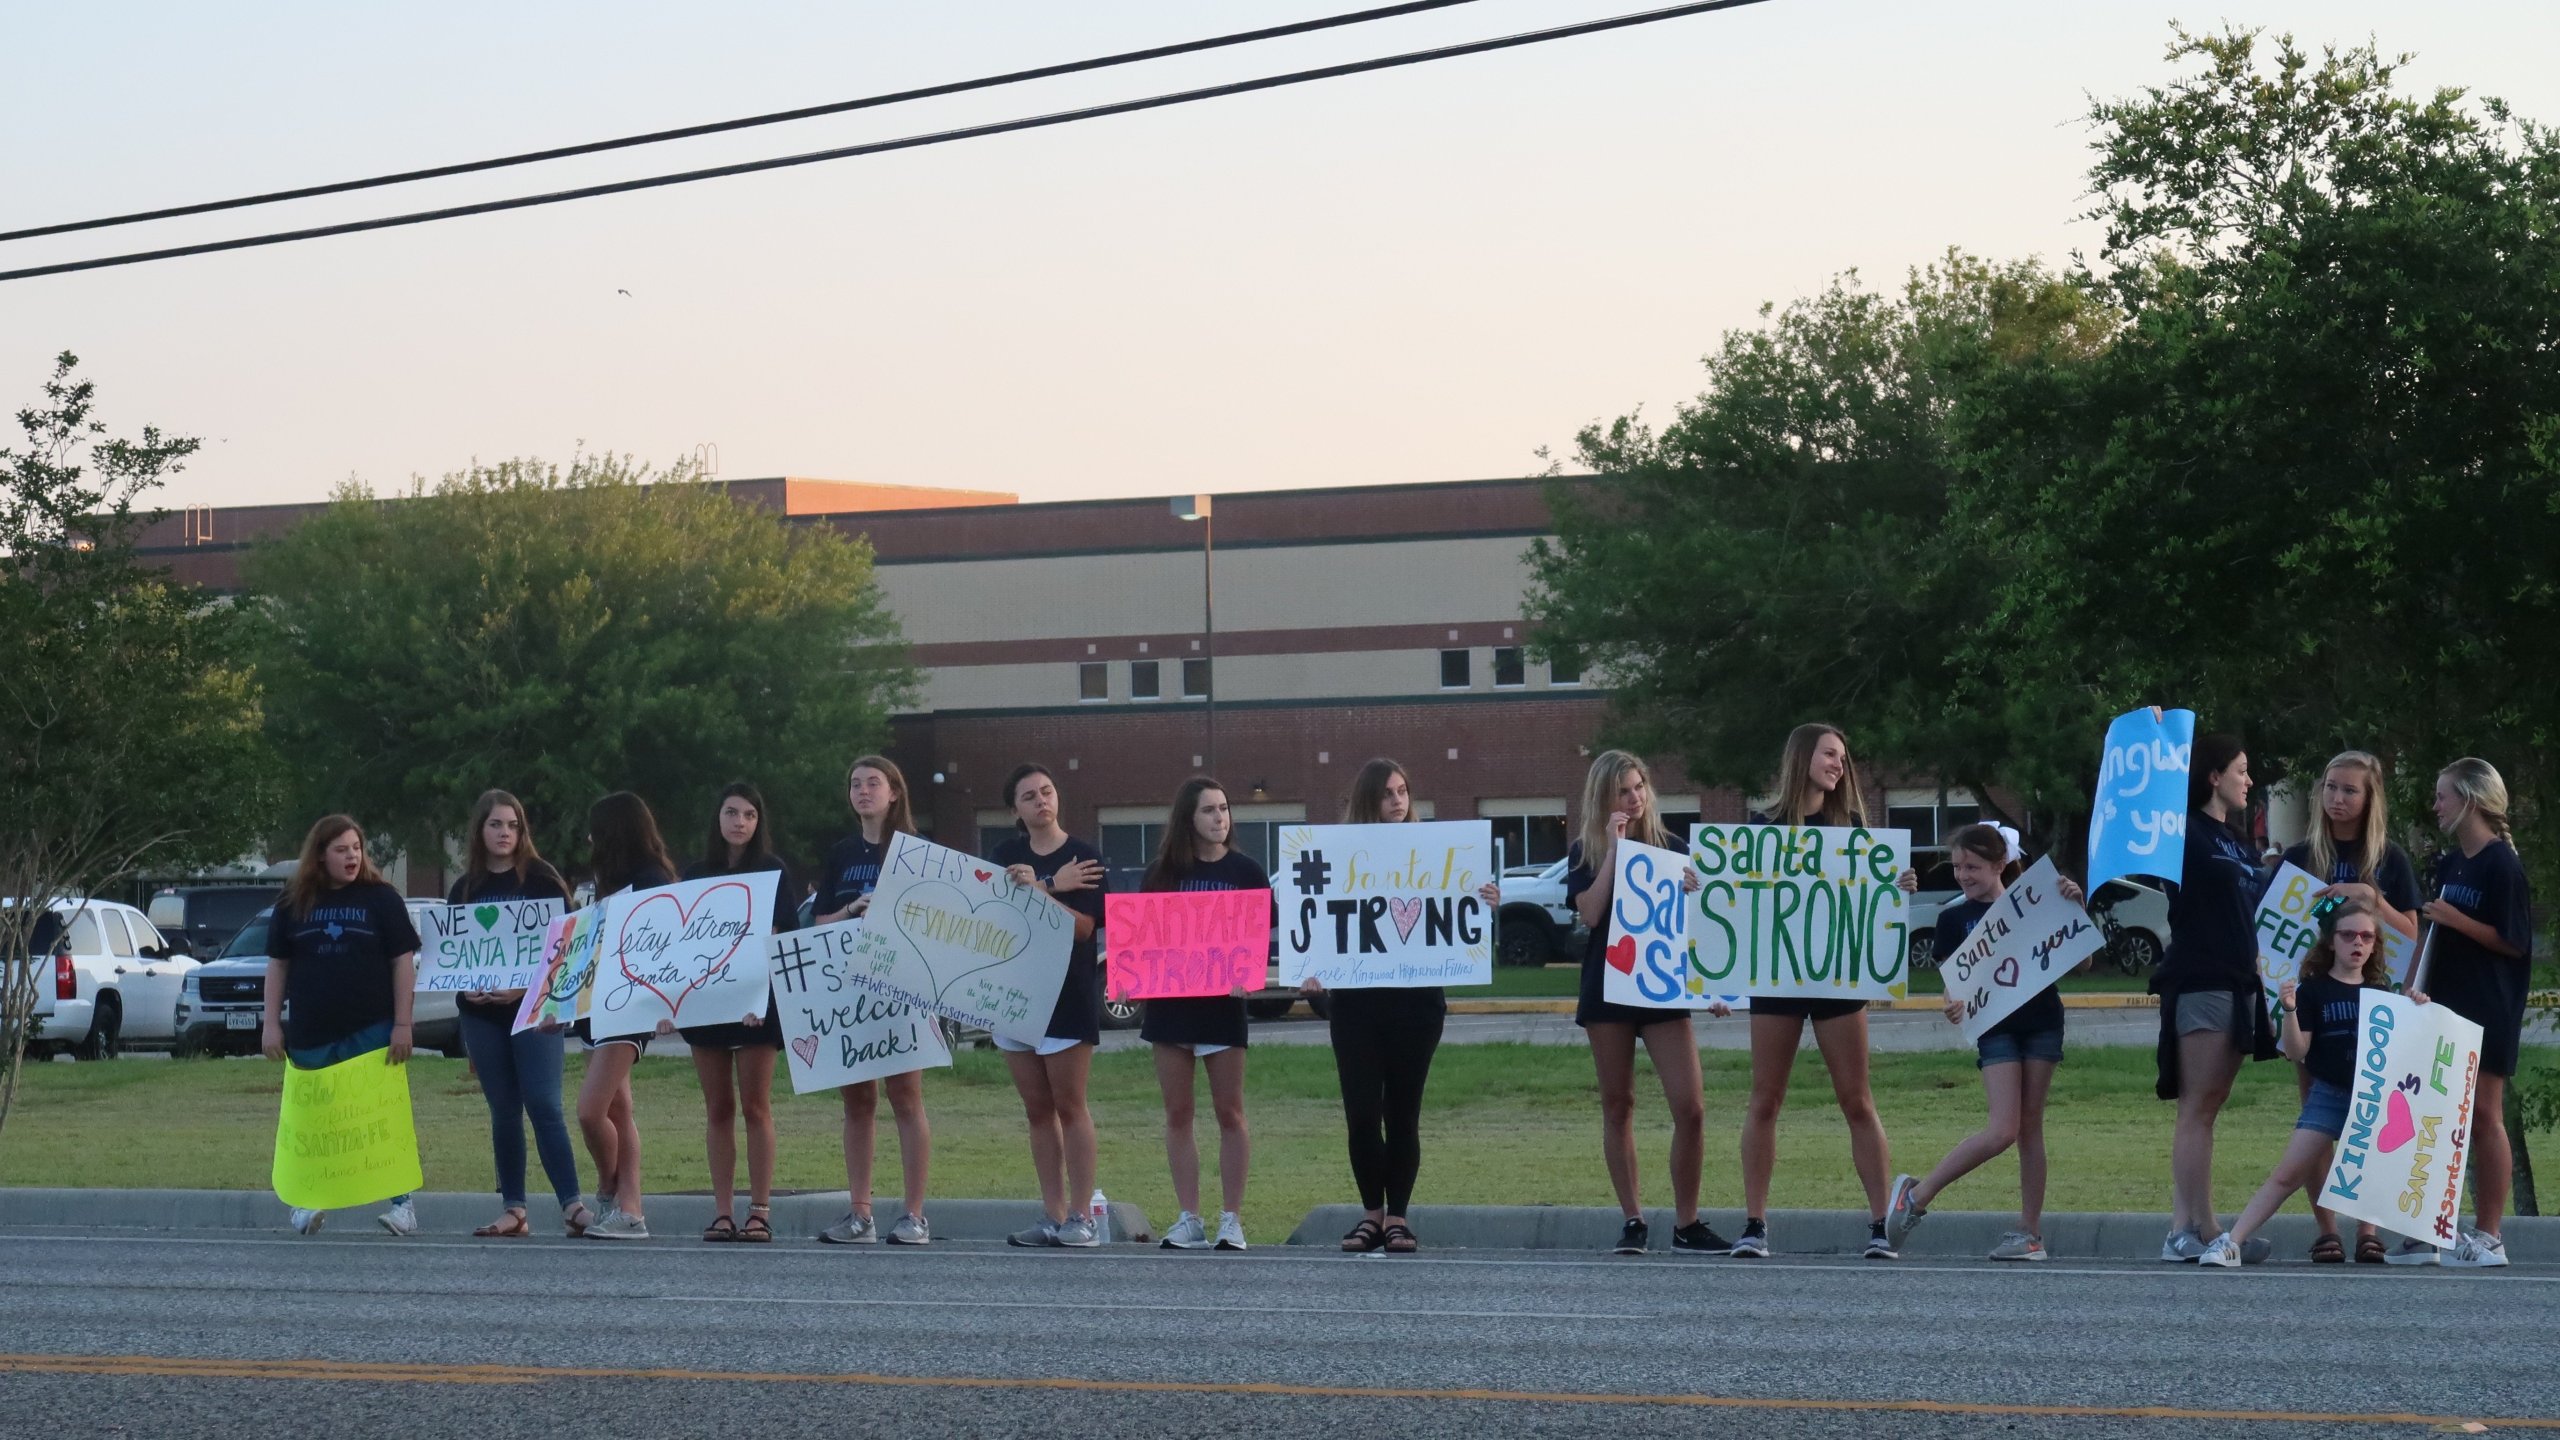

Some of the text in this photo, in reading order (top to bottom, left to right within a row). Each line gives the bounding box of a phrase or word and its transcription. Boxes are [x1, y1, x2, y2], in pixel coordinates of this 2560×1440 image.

[892, 836, 968, 883] KHS
[429, 902, 550, 937] WE YOU
[679, 908, 754, 946] strong
[1688, 878, 1906, 988] STRONG
[1956, 884, 2042, 981] Santa Fe
[2032, 919, 2092, 971] you
[437, 934, 542, 971] SANTA FE
[1115, 945, 1251, 997] STRONG
[428, 974, 502, 991] KINGWOOD
[605, 961, 686, 1012] Santa
[2329, 1004, 2395, 1200] KINGWOOD
[2398, 1035, 2456, 1218] SANTA FE
